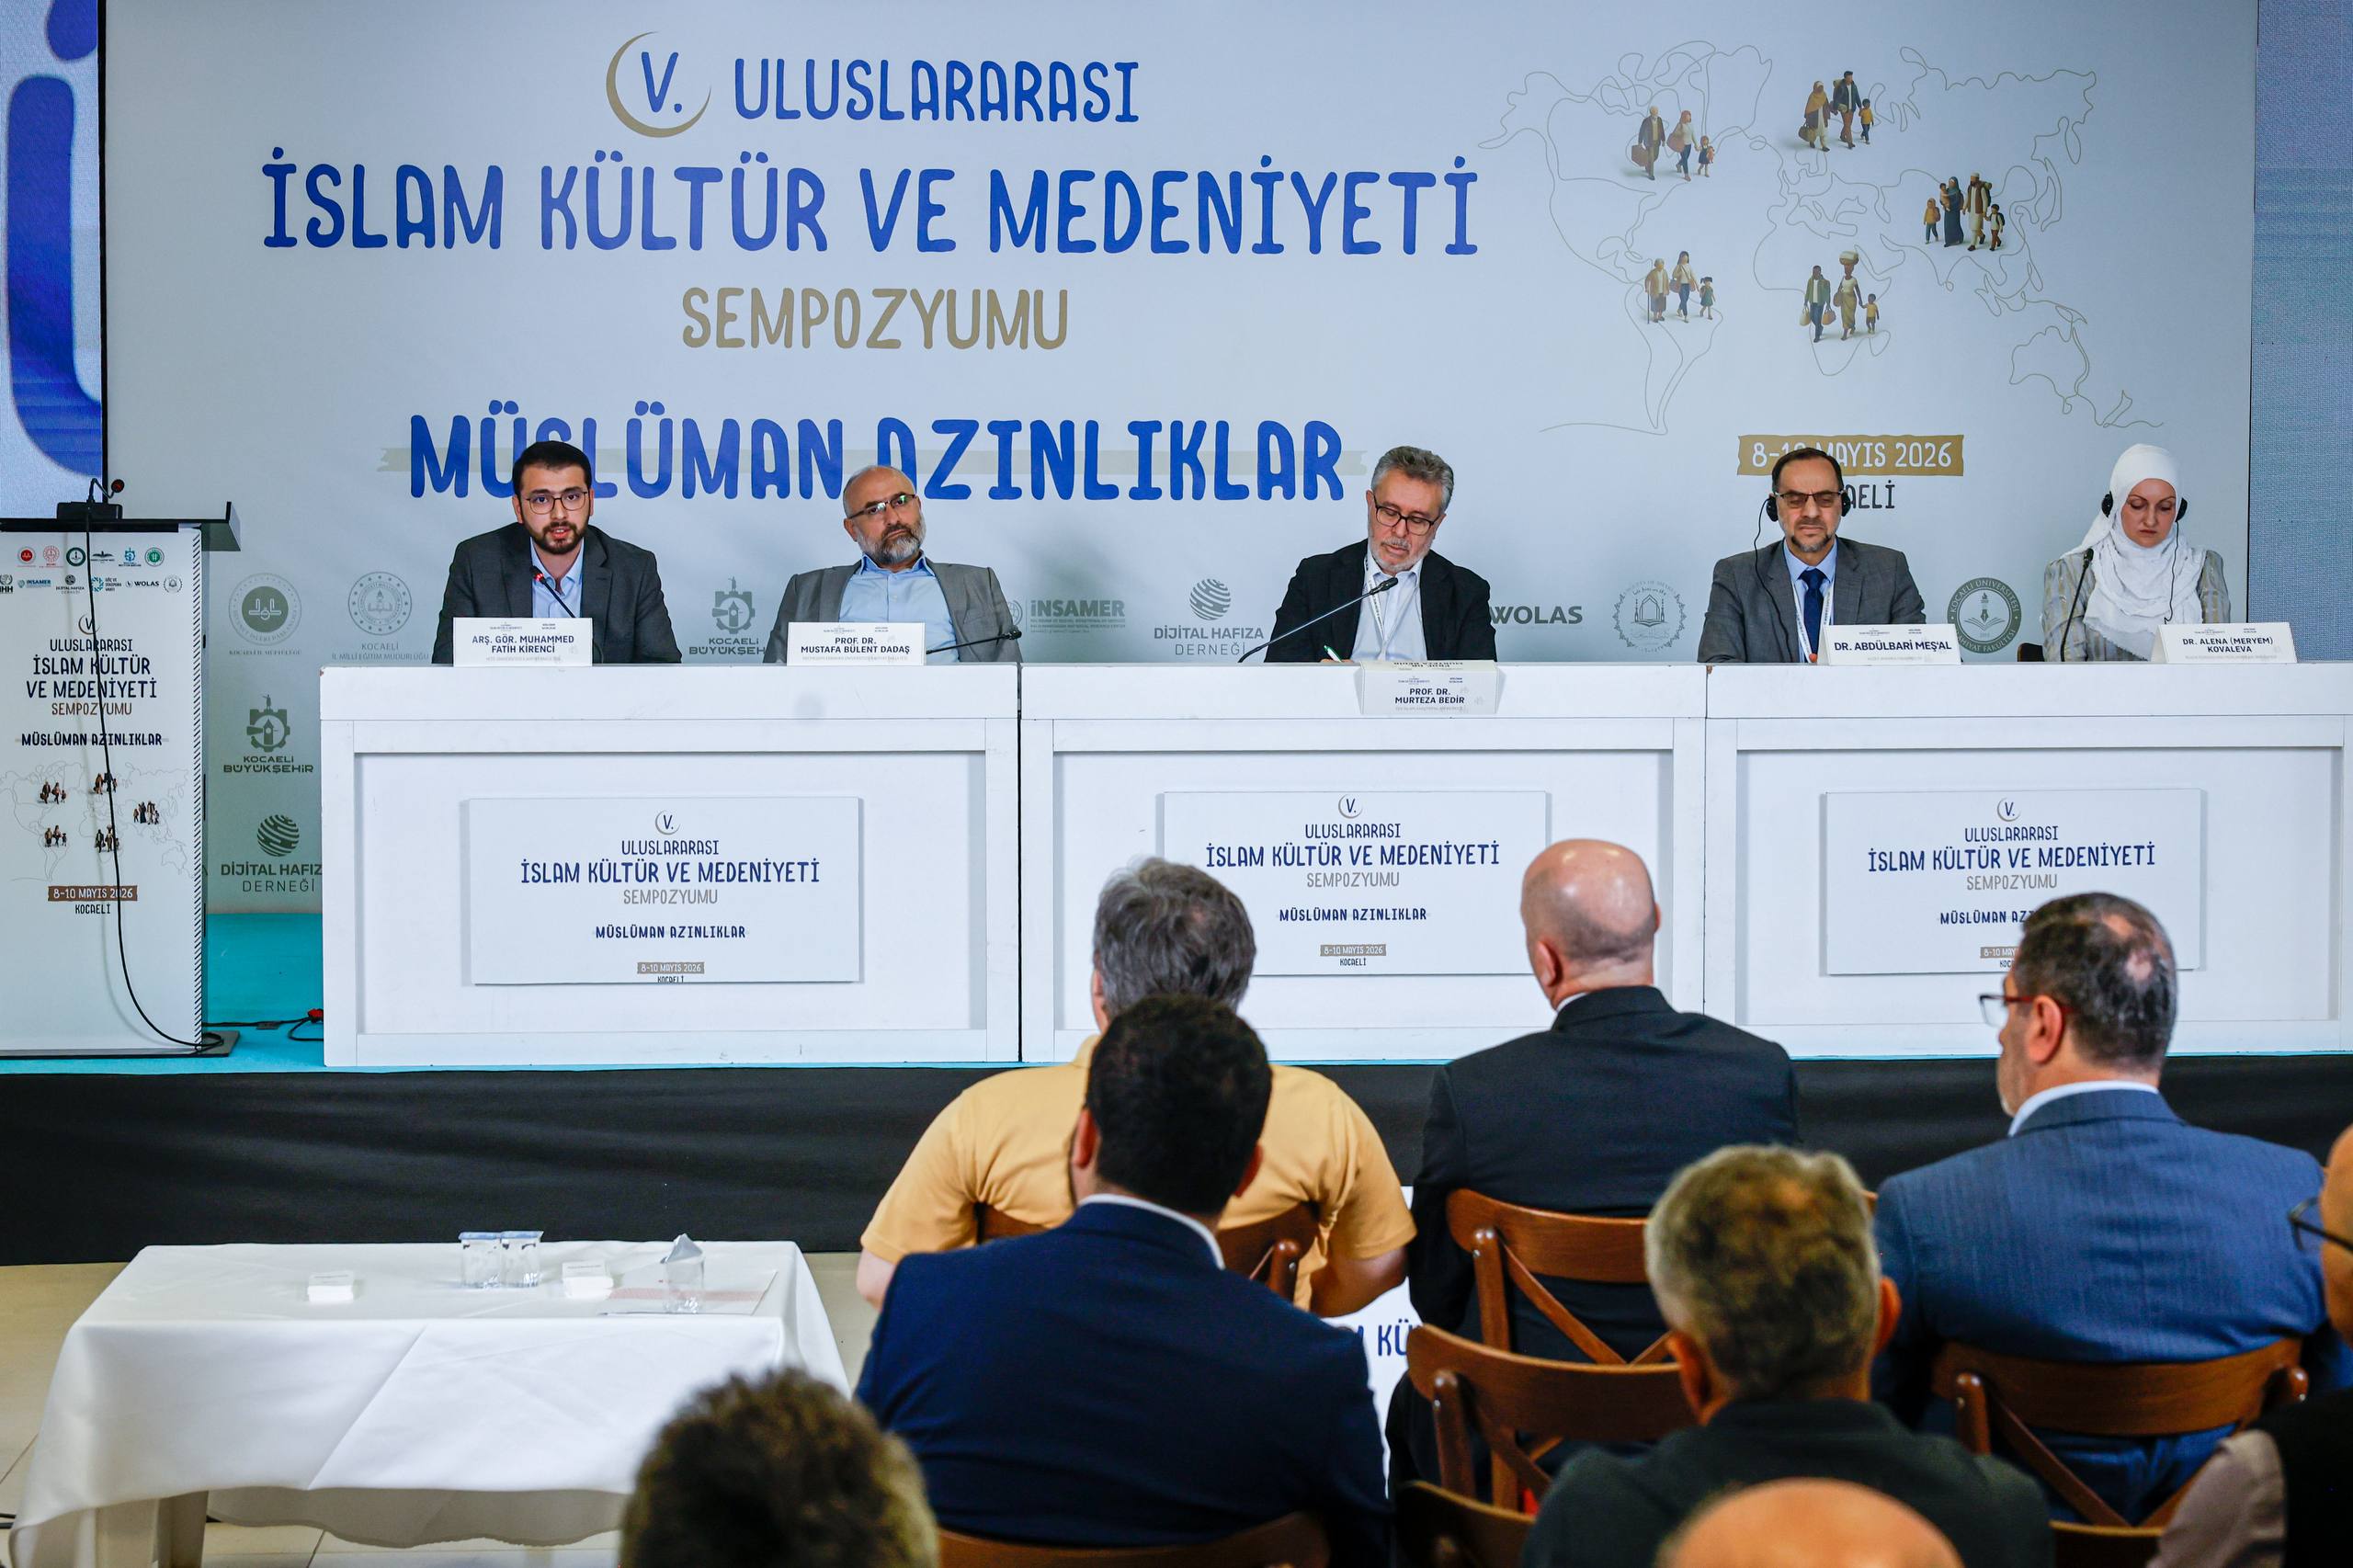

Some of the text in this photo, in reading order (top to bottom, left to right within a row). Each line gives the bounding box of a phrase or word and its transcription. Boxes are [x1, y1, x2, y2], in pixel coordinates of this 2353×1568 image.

[642, 51, 1139, 123] V. ULUSLARARASI
[262, 147, 1478, 256] İSLAM KÜLTÜR VE MEDENİYETİ
[682, 287, 1068, 350] SEMPOZYUMU
[410, 400, 843, 500] MÜLÜMAN
[1895, 442, 1952, 467] 2026
[1489, 606, 1583, 624] WOLAS
[472, 633, 574, 645] ARŞ. GÖR. MUHAMMED
[1154, 625, 1264, 639] DİJİTAL HAFIZA
[492, 643, 555, 653] FATİH KİRENCİ
[801, 643, 910, 654] MUSTAFA BÜLENT DADAŞ
[1835, 642, 1851, 651] DR.
[1855, 640, 1913, 651] ABDÜLBARİ
[2230, 637, 2273, 645] (MERYEM)
[33, 654, 83, 675] İSLAM
[27, 680, 47, 698] VE
[1439, 696, 1465, 704] BEDİR
[21, 732, 86, 746] MÜSLÜMAN
[1347, 798, 1357, 813] V.
[2005, 801, 2015, 817] V.
[664, 814, 674, 830] V.
[1305, 824, 1401, 838] ULUSLARARASI
[1964, 825, 2059, 843] ULUSLARARASI
[621, 840, 719, 855] ULUSLARARASI
[1206, 840, 1499, 867] İSLAM KÜLTÜR VE MEDENİYETİ
[1868, 842, 2155, 872] İSLAM KÜLTÜR VE MEDENİYETİ
[221, 861, 276, 875] DİJİTAL
[520, 858, 820, 883] İSLAM KÜLTÜR VE MEDENİYETİ
[243, 878, 314, 892] DERNEĞİ
[1307, 872, 1400, 888] SEMPOZYUMU
[1966, 874, 2057, 891] SEMPOZYUMU
[53, 888, 75, 899] 8-10
[78, 888, 107, 899] MAYIS
[623, 890, 718, 904] SEMPOZYUMU
[75, 903, 111, 914] KOCAELİ
[1279, 907, 1427, 922] MÜSLÜMAN AZINLIKLAR
[1940, 910, 2006, 925] MÜSLÜMAN
[596, 924, 746, 938] MÜSLÜMAN AZINLIKLAR
[1324, 947, 1340, 955] 8-10
[1339, 957, 1367, 967] KOCAELİ
